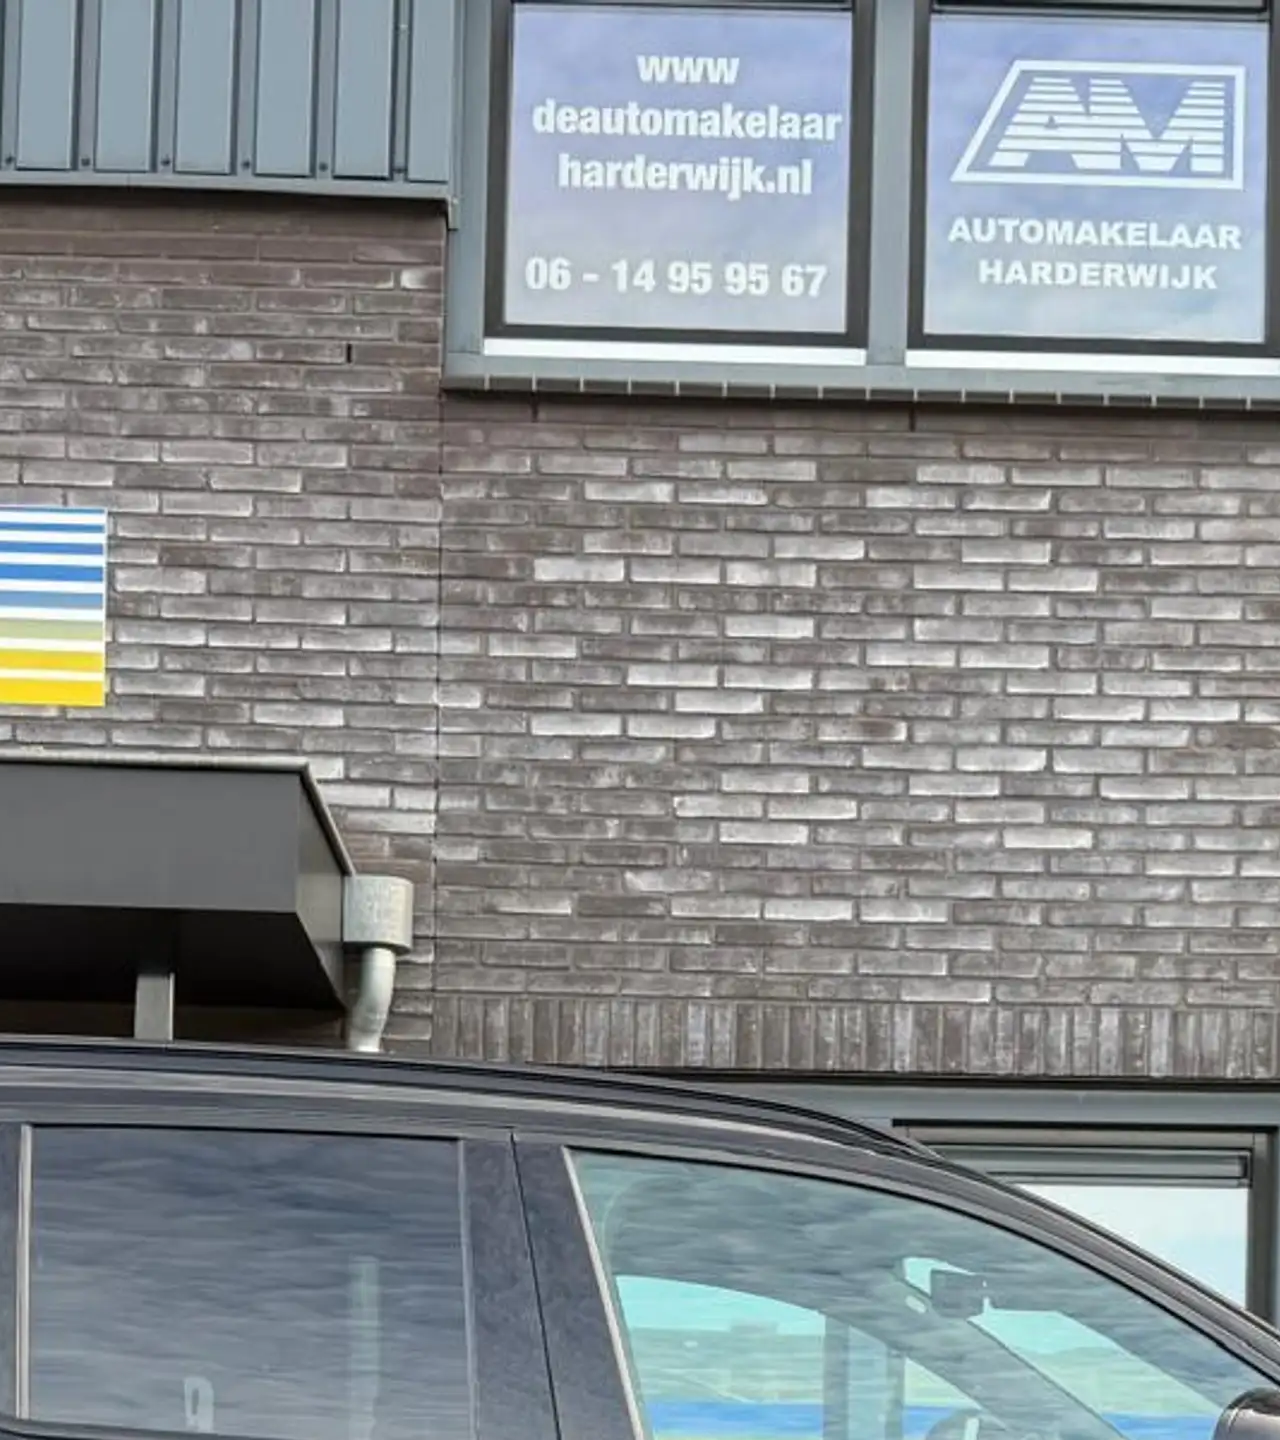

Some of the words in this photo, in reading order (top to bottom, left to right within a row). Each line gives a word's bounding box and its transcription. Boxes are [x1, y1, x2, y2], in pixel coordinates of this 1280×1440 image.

[636, 54, 740, 85] www
[532, 98, 843, 142] deautomakelaar
[558, 153, 813, 201] harderwijk.nl
[948, 217, 1243, 251] AUTOMAKELAAR
[525, 257, 572, 291] 06
[611, 260, 656, 293] 14
[667, 261, 713, 294] 95
[724, 261, 769, 296] 95
[781, 264, 828, 298] 67
[979, 259, 1218, 290] HARDERWIJK
